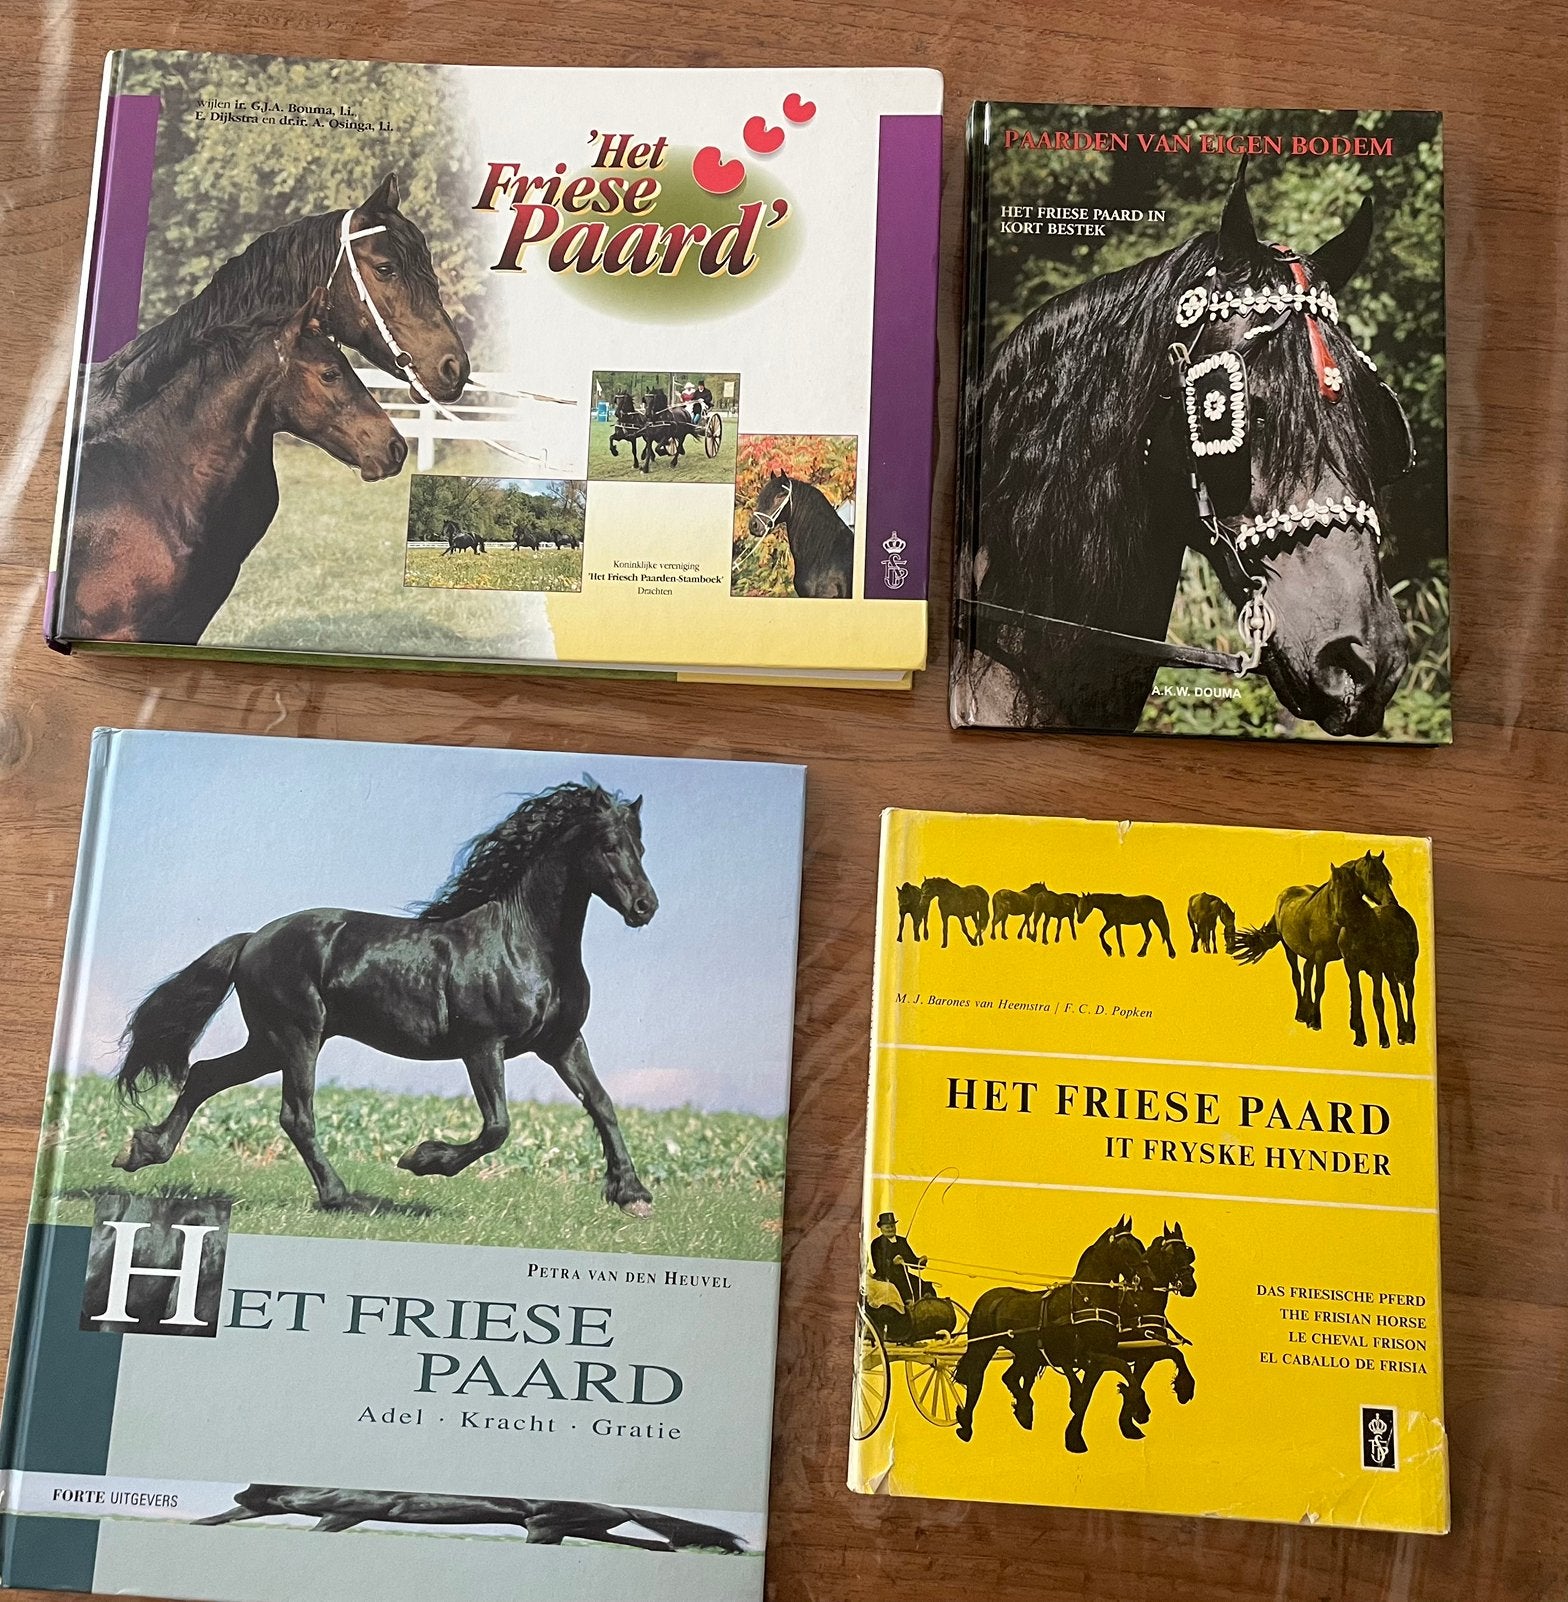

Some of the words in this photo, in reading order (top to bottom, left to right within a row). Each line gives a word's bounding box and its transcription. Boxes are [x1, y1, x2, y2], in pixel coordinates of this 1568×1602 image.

[198, 99, 231, 112] wijlen
[288, 104, 335, 116] Bouma,
[195, 111, 206, 121] E.
[210, 112, 258, 124] Dijkstra
[312, 118, 324, 127] A.
[328, 119, 375, 132] Osinga,
[1004, 130, 1128, 152] PAARDEN
[1137, 133, 1190, 153] VAN
[1200, 134, 1282, 155] EIGEN
[1292, 136, 1393, 156] BODEM
[472, 162, 662, 214] Friese
[1001, 206, 1033, 219] HET
[1037, 207, 1089, 220] FRIESE
[1093, 208, 1144, 221] PAARD
[1148, 210, 1166, 222] IN
[1000, 221, 1043, 234] KORT
[1047, 223, 1106, 237] BESTEK
[613, 560, 657, 571] Koninklijke
[660, 562, 700, 572] vereniging
[608, 573, 638, 581] Friesch
[637, 587, 673, 596] Drachten
[1151, 686, 1191, 697] A.K.W.
[1194, 687, 1242, 699] DOUMA
[895, 993, 909, 1004] M.
[913, 993, 923, 1005] J.
[927, 995, 970, 1008] Barones
[975, 1000, 993, 1009] van
[998, 999, 1051, 1012] Heemstra
[1064, 1003, 1074, 1014] F.
[1078, 1003, 1092, 1015] C.
[1095, 1004, 1108, 1016] D.
[1111, 1005, 1153, 1019] Popken
[946, 1077, 1037, 1113] HET
[1055, 1083, 1220, 1125] FRIESE
[1239, 1096, 1391, 1136] PAARD
[1105, 1136, 1134, 1159] IT
[1143, 1139, 1255, 1168] FRYSKE
[1266, 1147, 1391, 1176] HYNDER
[90, 1220, 325, 1332] HET
[342, 1294, 615, 1349] FRIESE
[1257, 1285, 1285, 1297] DAS
[1290, 1287, 1374, 1304] FRIESISCHE
[1379, 1293, 1426, 1307] PFERD
[1280, 1308, 1309, 1321] THE
[1314, 1311, 1371, 1325] FRISIAN
[1376, 1315, 1427, 1329] HORSE
[1289, 1331, 1306, 1343] LE
[1311, 1333, 1368, 1348] CHEVAL
[1373, 1337, 1427, 1351] FRISON
[1260, 1352, 1277, 1364] EL
[1282, 1353, 1350, 1369] CABALLO
[1355, 1358, 1375, 1370] DE
[1380, 1360, 1427, 1374] FRISIA
[413, 1352, 684, 1406] PAARD
[357, 1406, 424, 1426] Adel
[461, 1411, 557, 1433] Kracht
[592, 1418, 682, 1441] Gratie
[53, 1488, 105, 1504] FORTE
[110, 1491, 179, 1508] UITGEVERS
